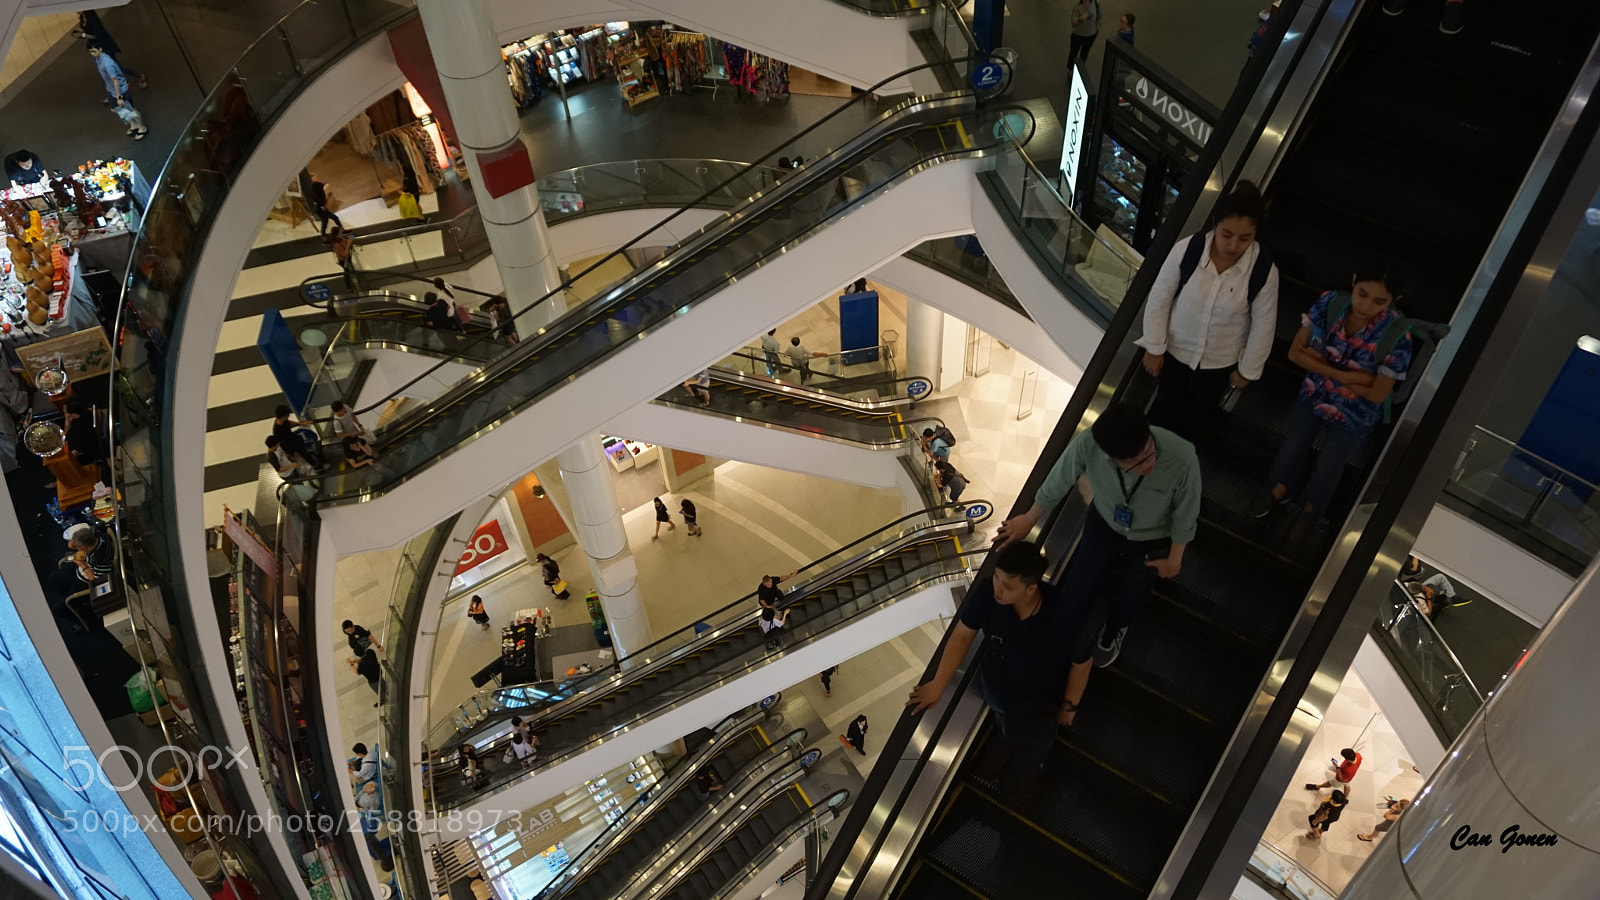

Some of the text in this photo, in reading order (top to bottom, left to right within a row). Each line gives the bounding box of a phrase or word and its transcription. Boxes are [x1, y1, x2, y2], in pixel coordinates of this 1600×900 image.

[982, 66, 993, 81] 2
[1068, 88, 1083, 164] NIXON
[971, 506, 981, 516] M
[515, 808, 554, 837] LAB
